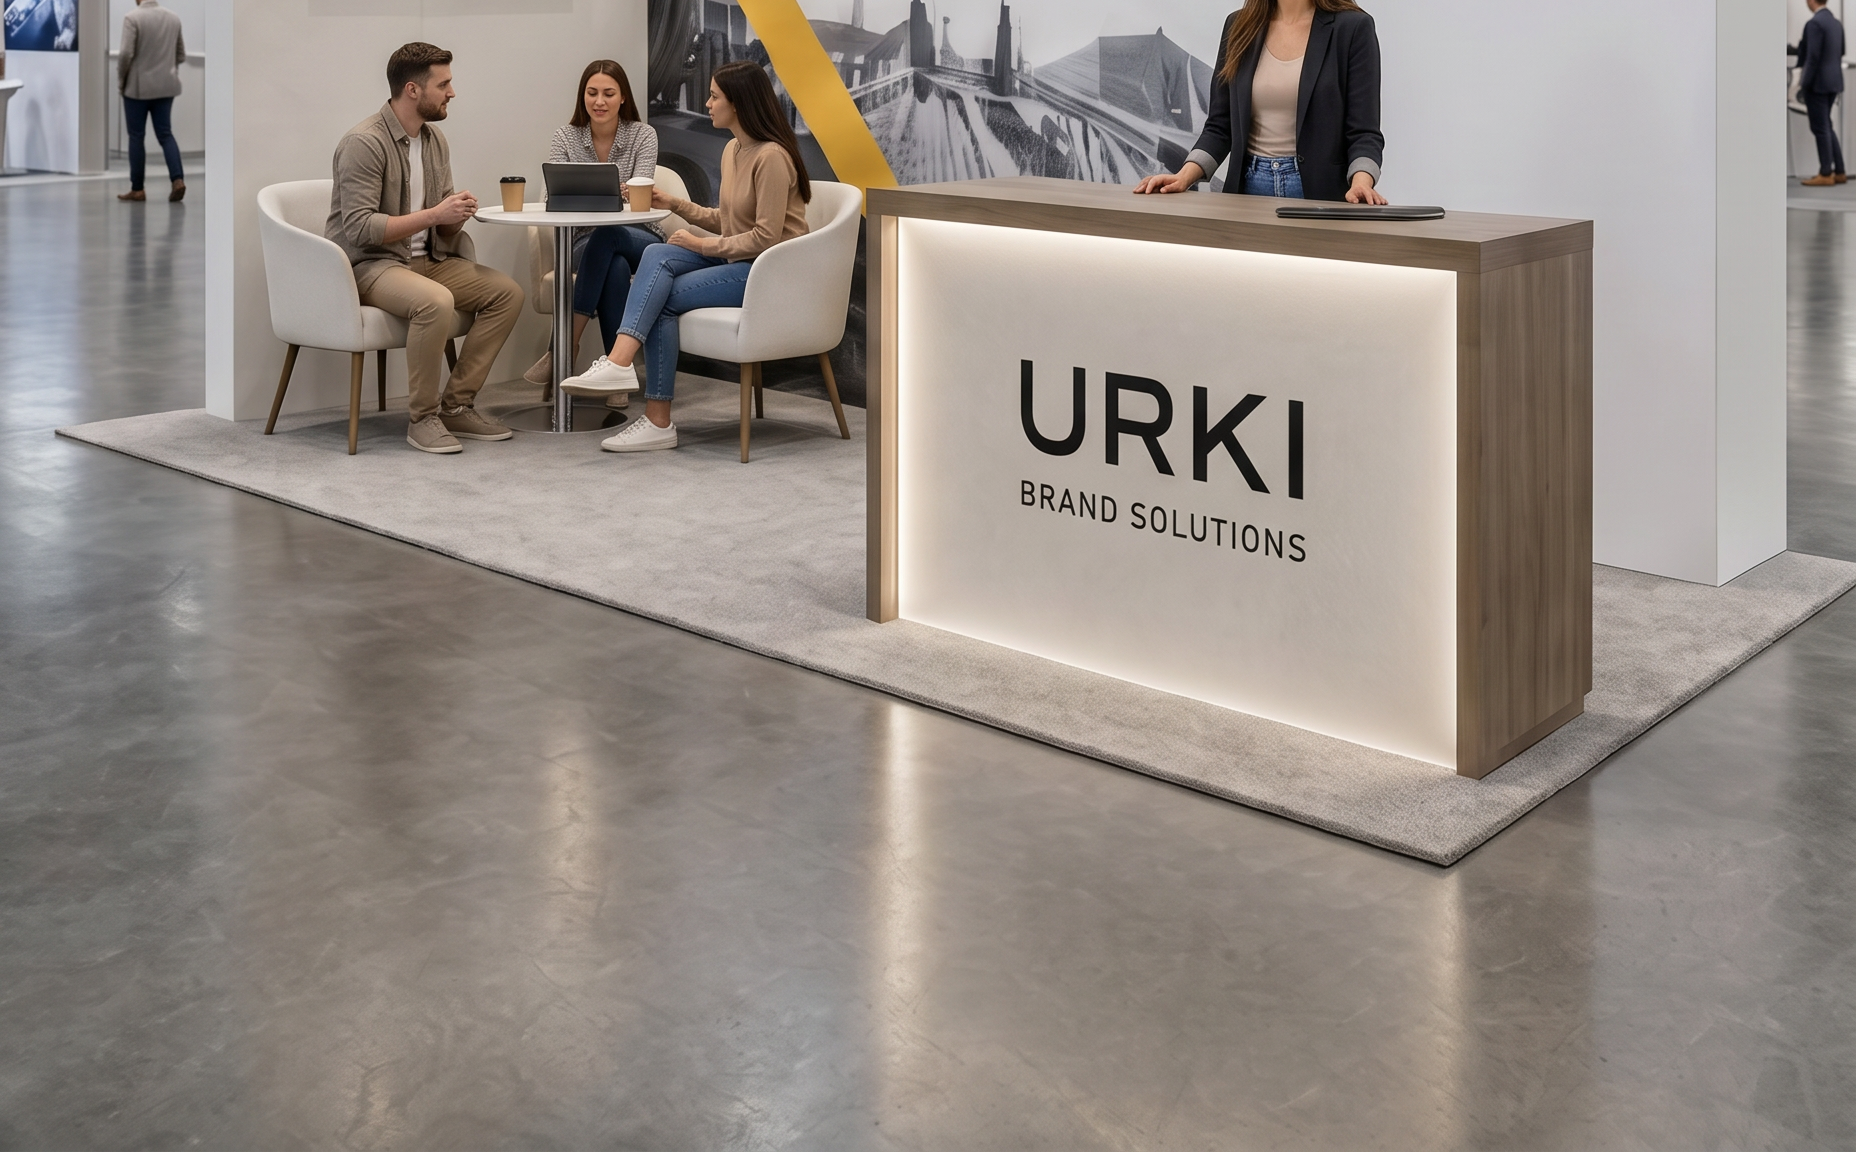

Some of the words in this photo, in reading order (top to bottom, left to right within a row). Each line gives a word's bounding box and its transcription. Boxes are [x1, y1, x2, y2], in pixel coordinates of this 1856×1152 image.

[1020, 358, 1304, 501] URKI
[1021, 479, 1117, 524] BRAND
[1130, 502, 1306, 564] SOLUTIONS
